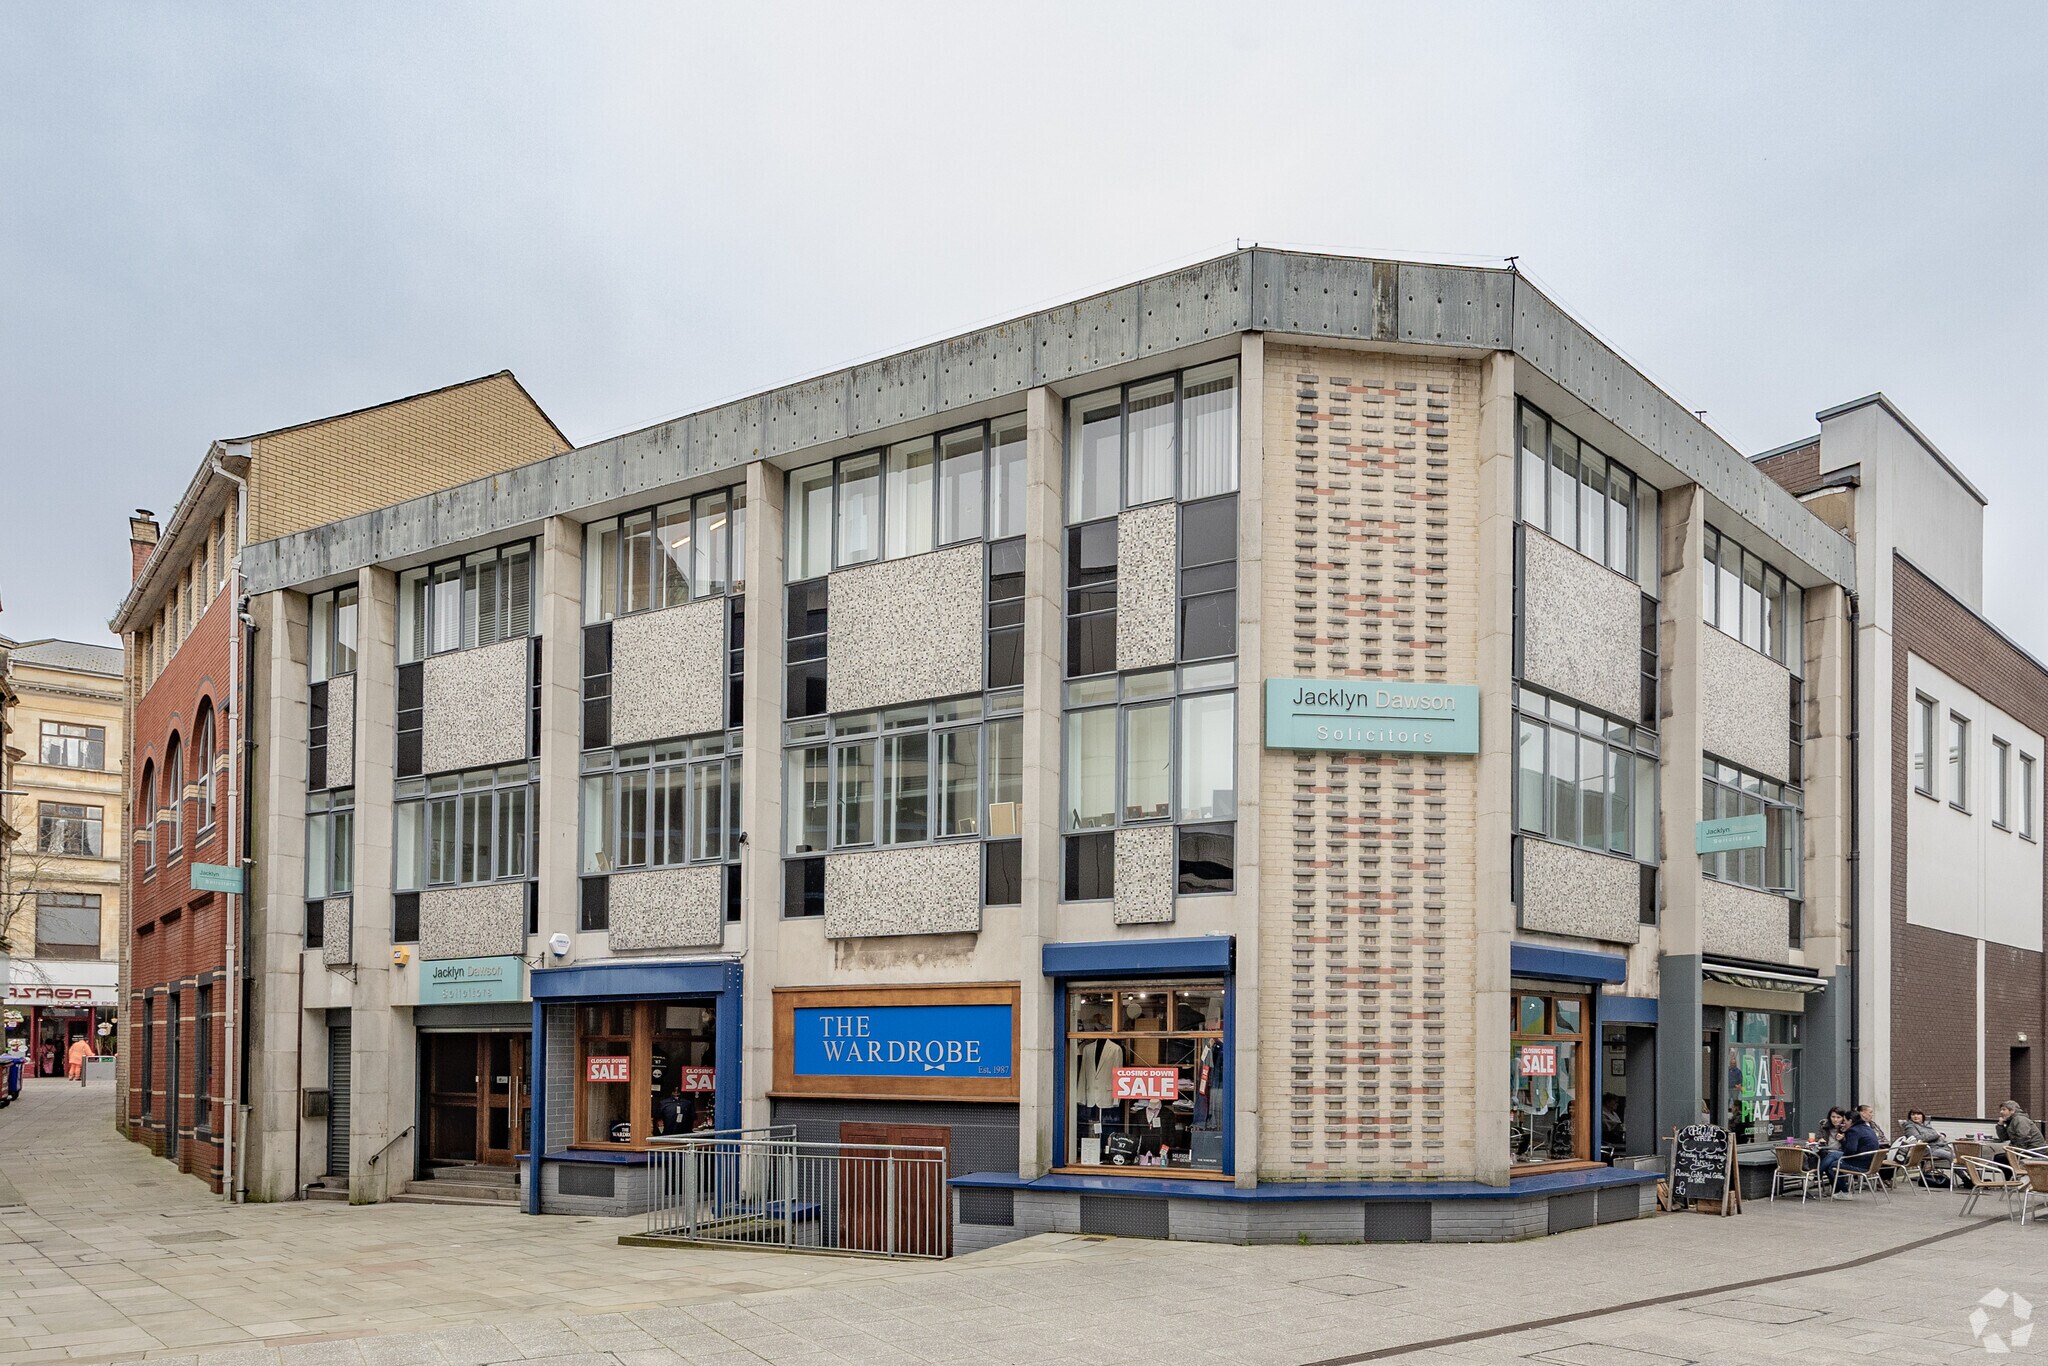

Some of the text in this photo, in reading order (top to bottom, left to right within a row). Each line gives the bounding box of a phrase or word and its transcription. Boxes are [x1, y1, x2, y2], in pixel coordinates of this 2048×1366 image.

[1293, 687, 1456, 711] Jacklyn Dawson
[1316, 726, 1433, 743] Solicitors
[1706, 827, 1730, 835] Jacklyn
[432, 965, 503, 980] Jacklyn Dawson
[442, 987, 493, 999] Solicitors
[819, 1016, 871, 1038] THE
[822, 1040, 982, 1063] WARDROBE
[590, 1064, 628, 1080] SALE
[978, 1065, 1009, 1074] Est. 1987
[1523, 1055, 1554, 1073] SALE
[1742, 1055, 1785, 1097] BAR
[1117, 1077, 1175, 1097] SALE
[1741, 1099, 1787, 1123] PIAZZA
